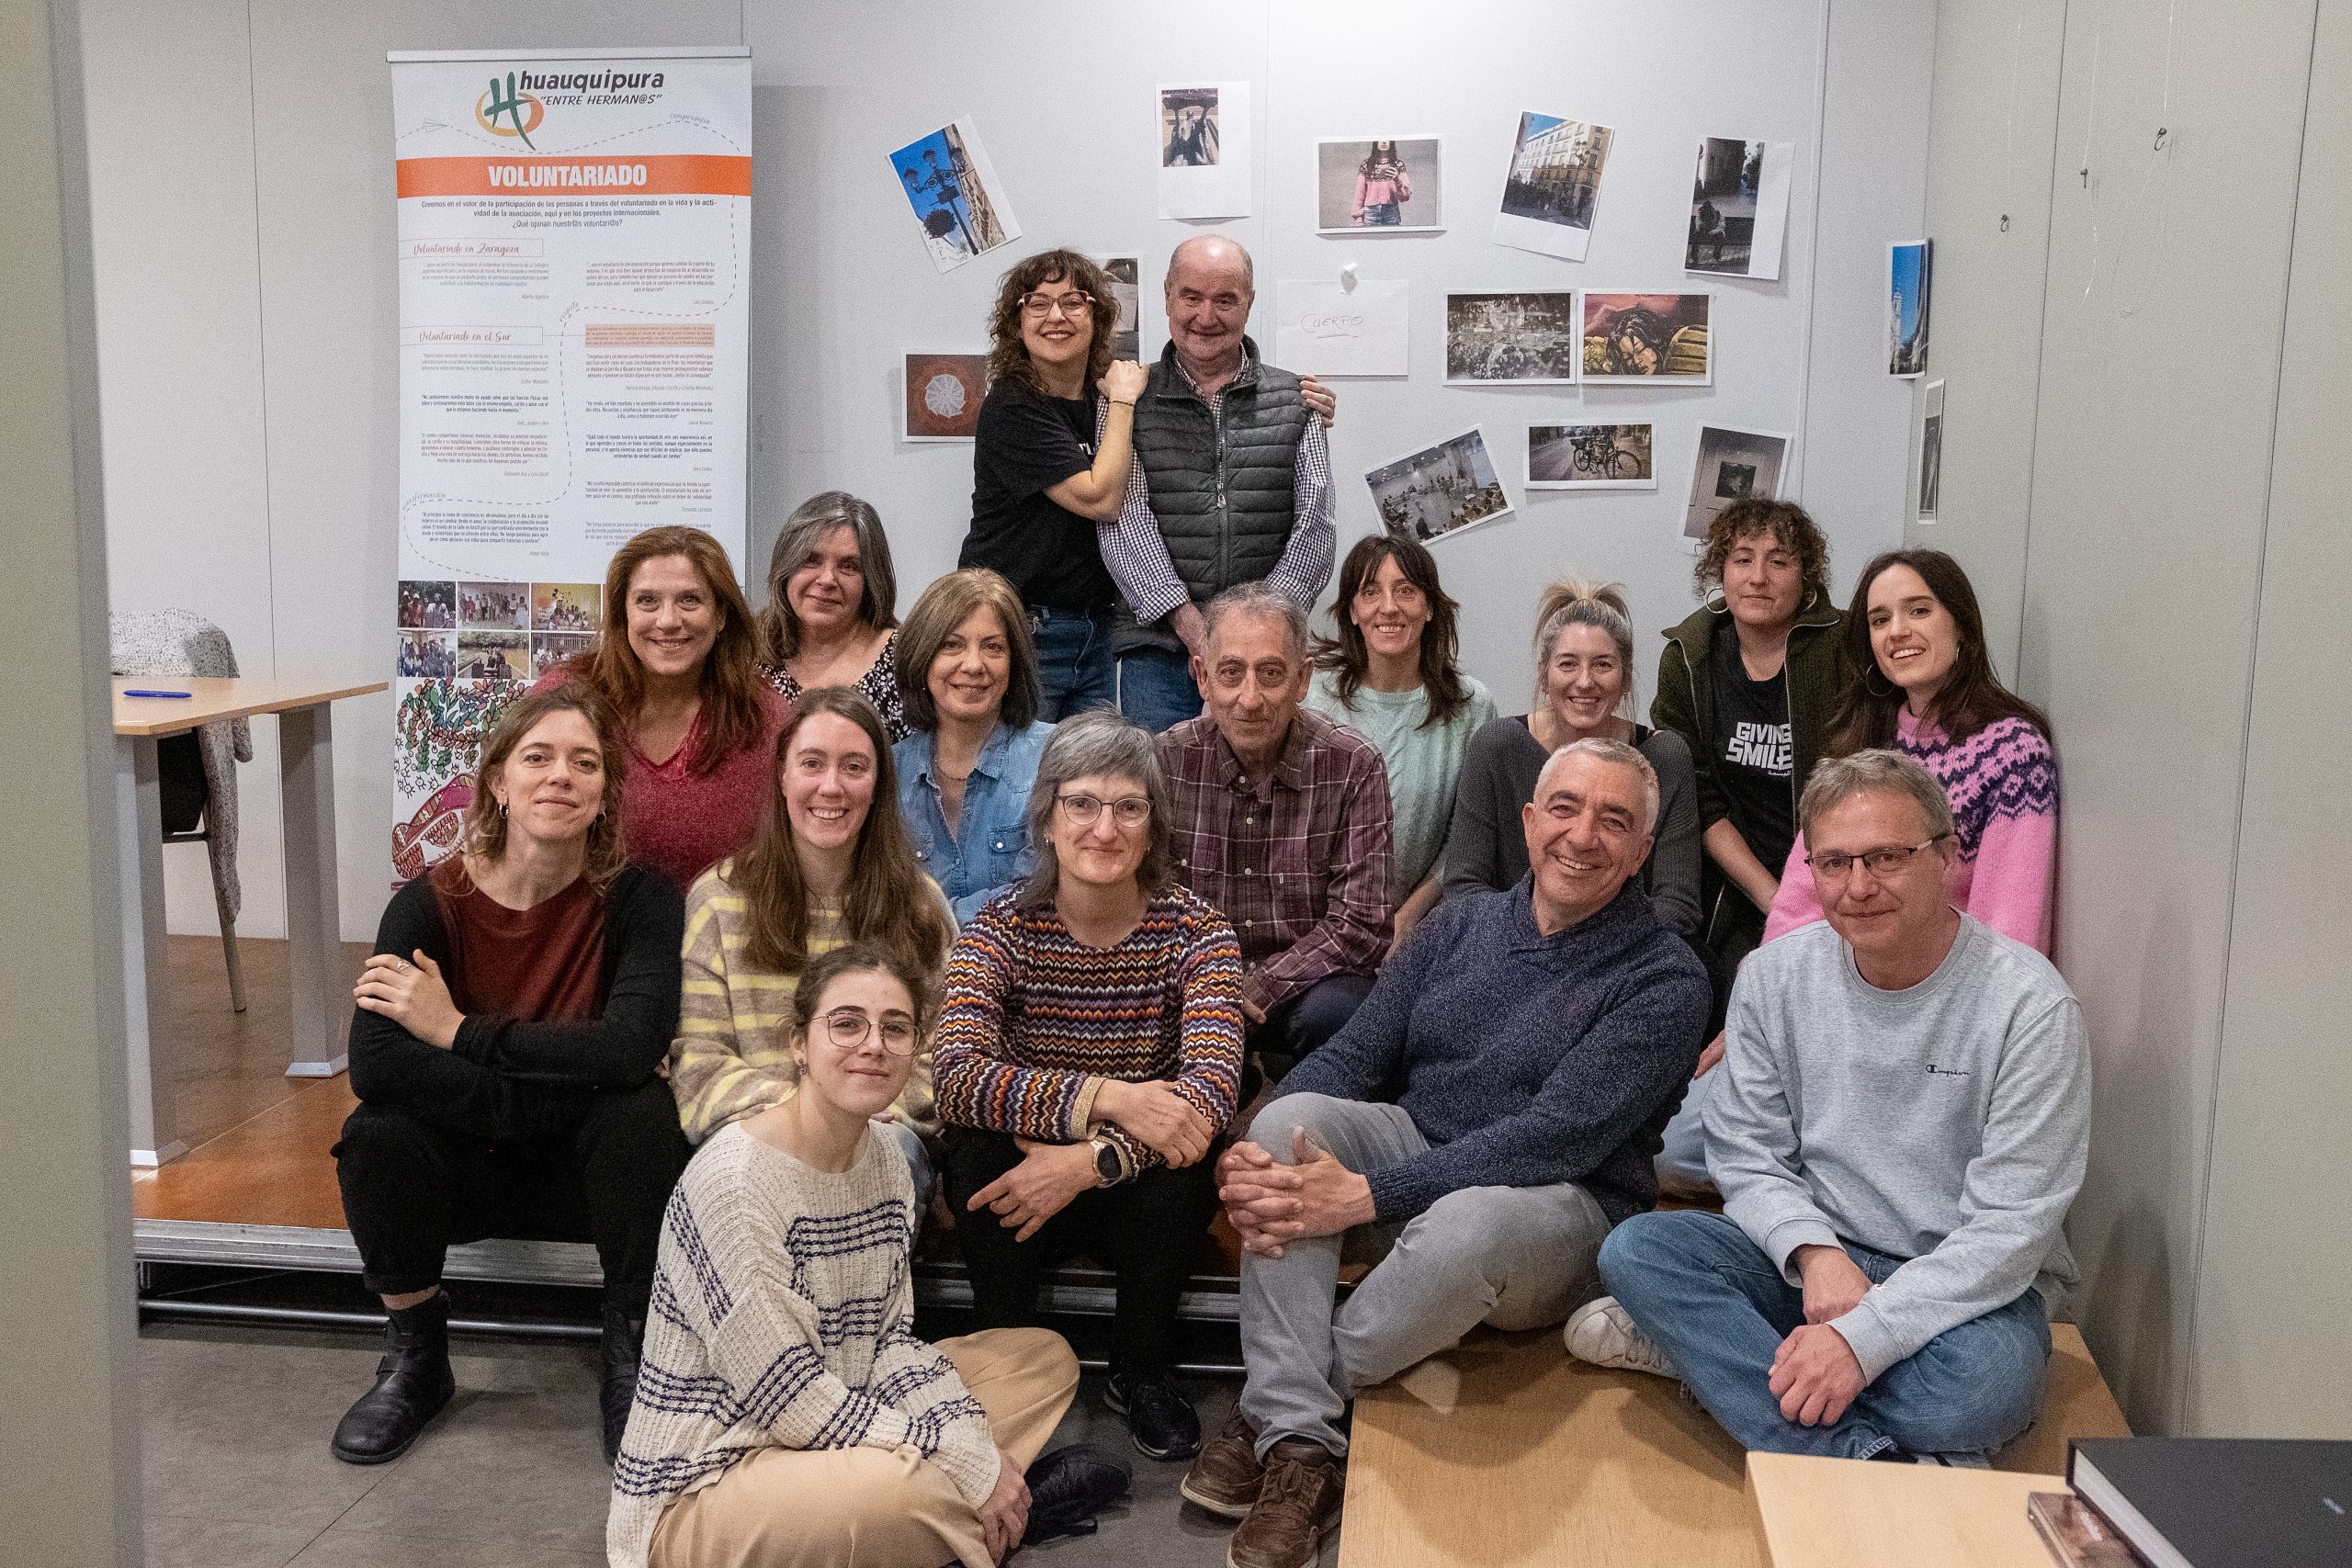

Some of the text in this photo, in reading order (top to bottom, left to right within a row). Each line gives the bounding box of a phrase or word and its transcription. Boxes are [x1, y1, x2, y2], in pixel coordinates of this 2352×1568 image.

[519, 69, 664, 93] huauquipura
[488, 164, 647, 188] VOLUNTARIADO
[582, 209, 612, 218] proyectos
[413, 243, 461, 254] Voluntariado
[477, 243, 519, 255] Zaragoza
[1301, 313, 1363, 333] CUERPO
[419, 331, 511, 343] Voluntariado en el Sur
[1736, 721, 1792, 745] GIVING
